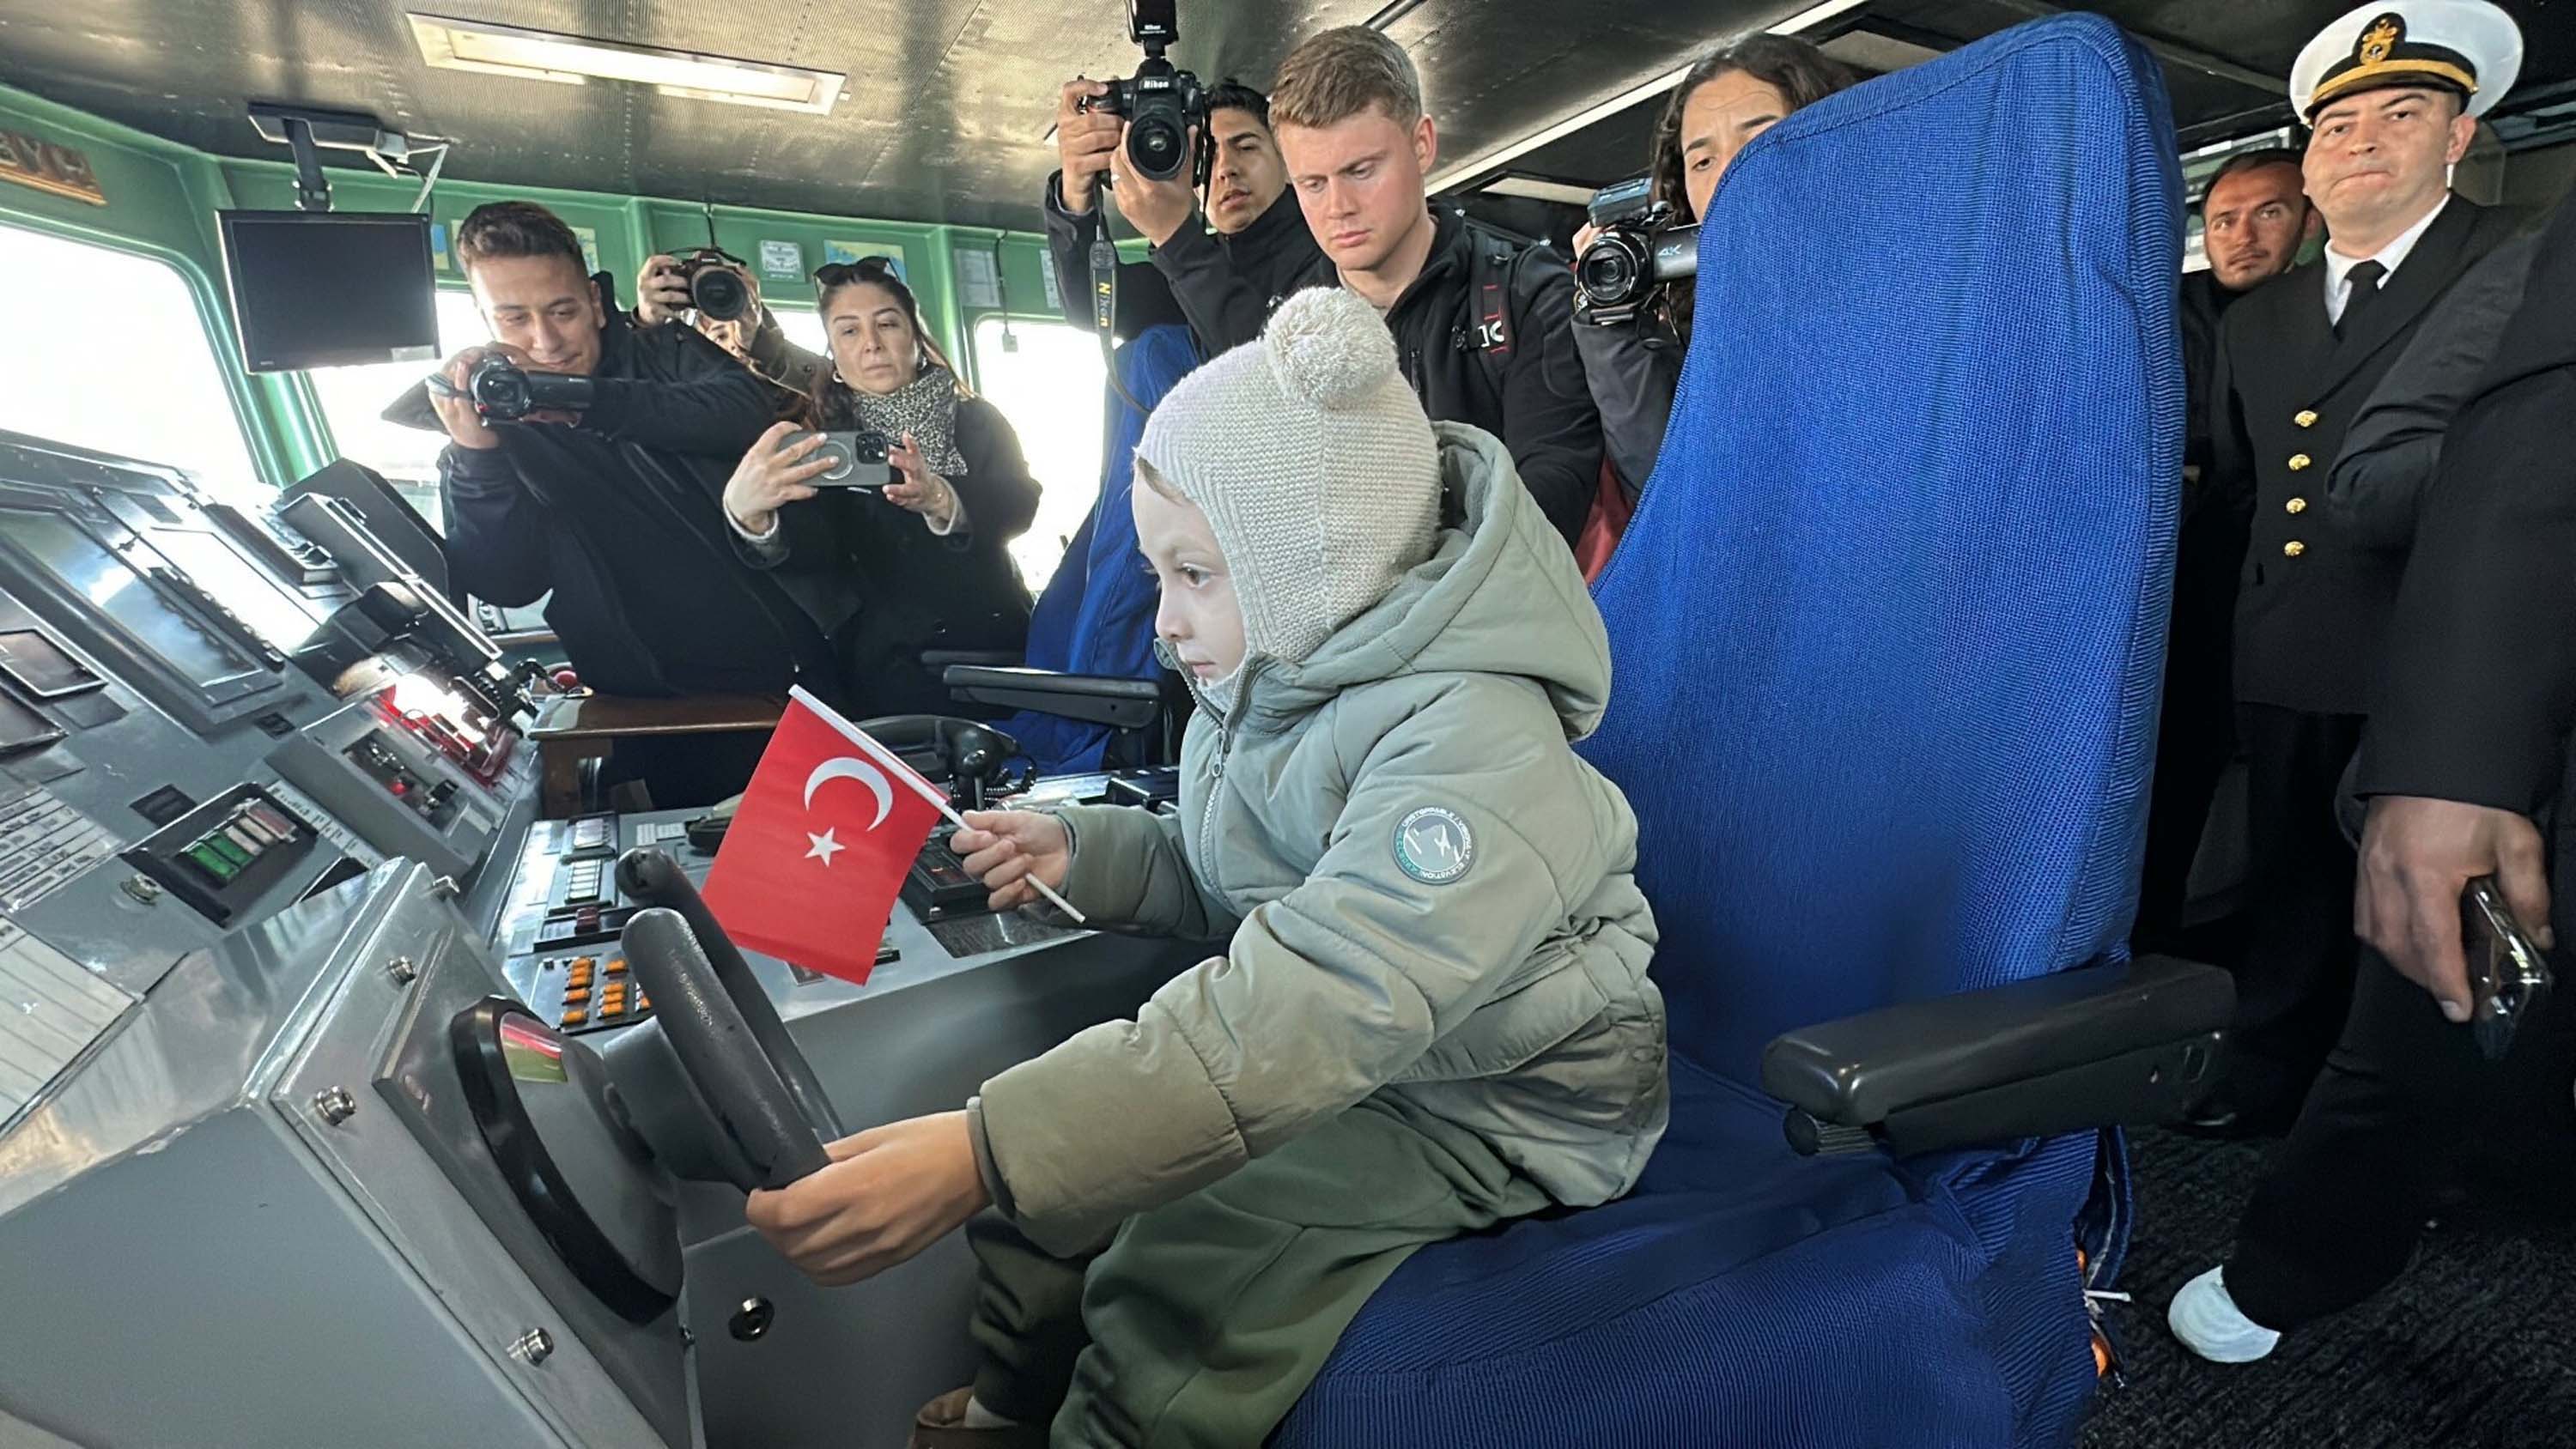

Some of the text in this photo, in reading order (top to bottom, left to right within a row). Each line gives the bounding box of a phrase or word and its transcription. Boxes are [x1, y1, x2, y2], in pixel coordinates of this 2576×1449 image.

[1144, 80, 1170, 88] Nikon
[1658, 244, 1683, 257] 4K
[1098, 282, 1112, 328] Nikon
